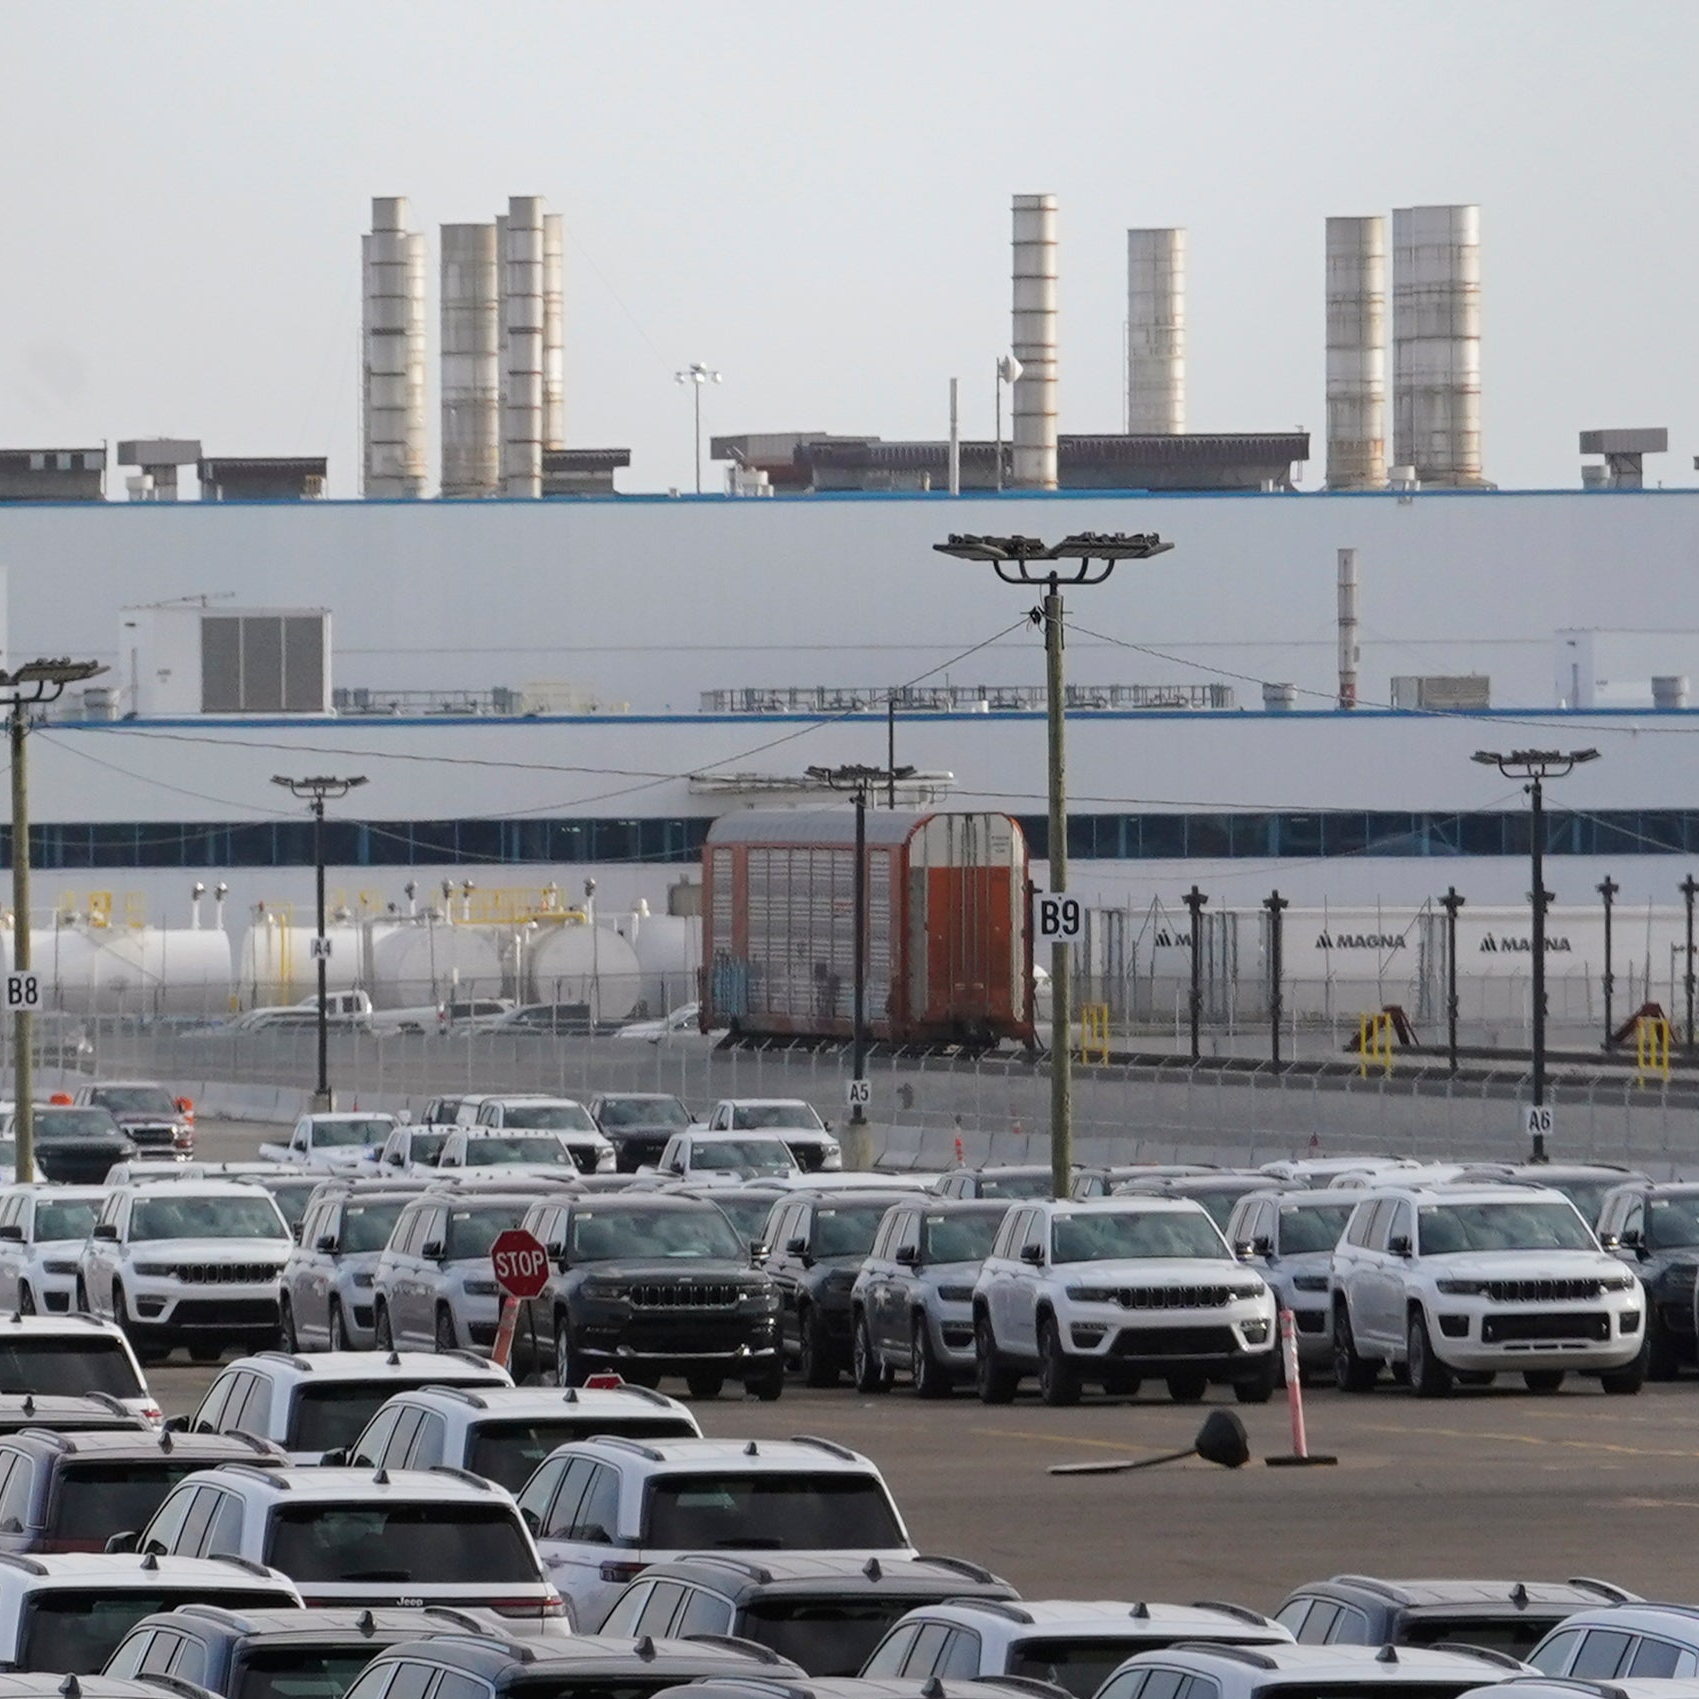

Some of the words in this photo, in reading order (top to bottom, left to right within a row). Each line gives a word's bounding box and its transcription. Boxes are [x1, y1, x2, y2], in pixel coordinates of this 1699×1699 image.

[1041, 901, 1079, 935] B9
[314, 940, 331, 955] A4
[1336, 935, 1405, 949] MAGNA
[1501, 937, 1571, 952] MANA
[8, 977, 37, 1005] B8
[850, 1084, 868, 1102] A5
[1529, 1111, 1550, 1129] A6
[496, 1250, 544, 1276] STOP
[396, 1597, 423, 1607] Jeep
